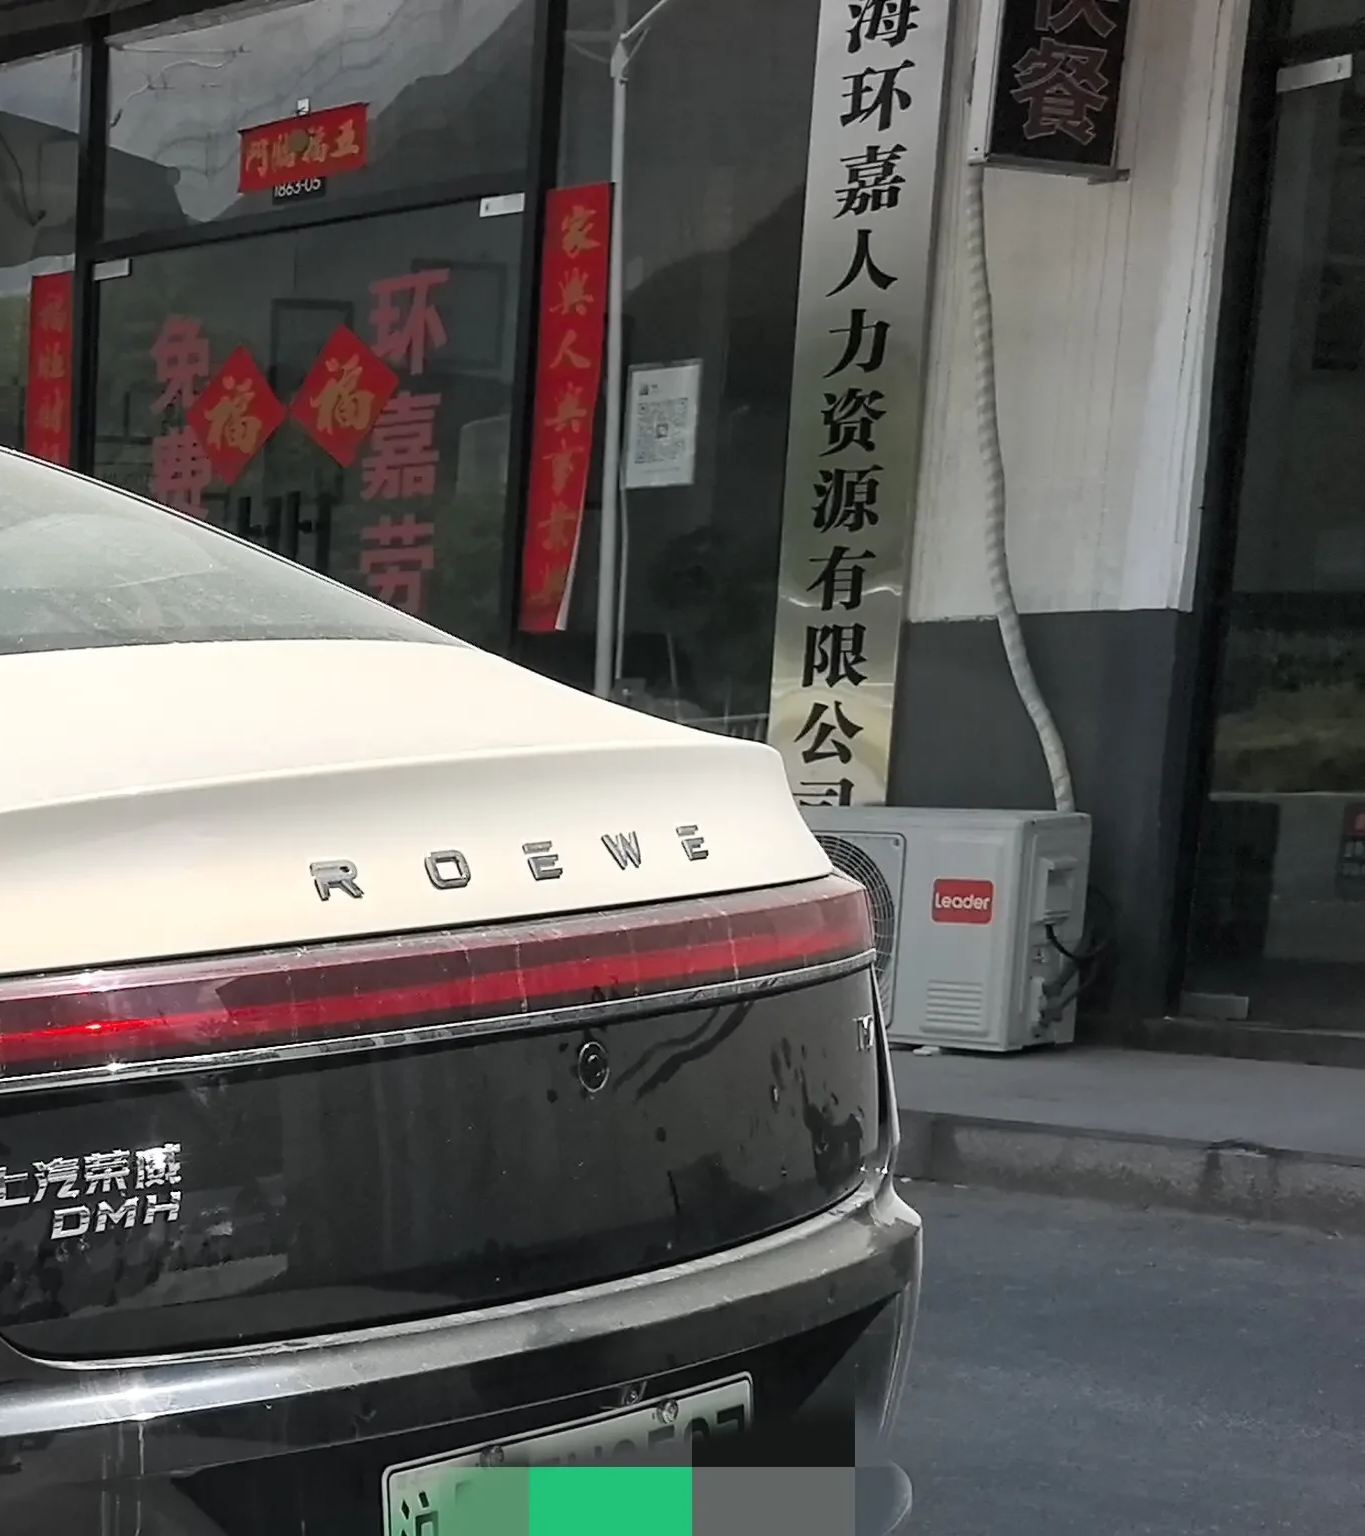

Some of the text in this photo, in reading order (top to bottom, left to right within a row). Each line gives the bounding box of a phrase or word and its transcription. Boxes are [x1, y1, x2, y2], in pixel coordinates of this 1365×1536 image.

[204, 376, 261, 455] 福
[309, 354, 375, 435] 福
[309, 823, 710, 901] ROEWE
[935, 892, 991, 910] Leader
[50, 1191, 182, 1240] DMH
